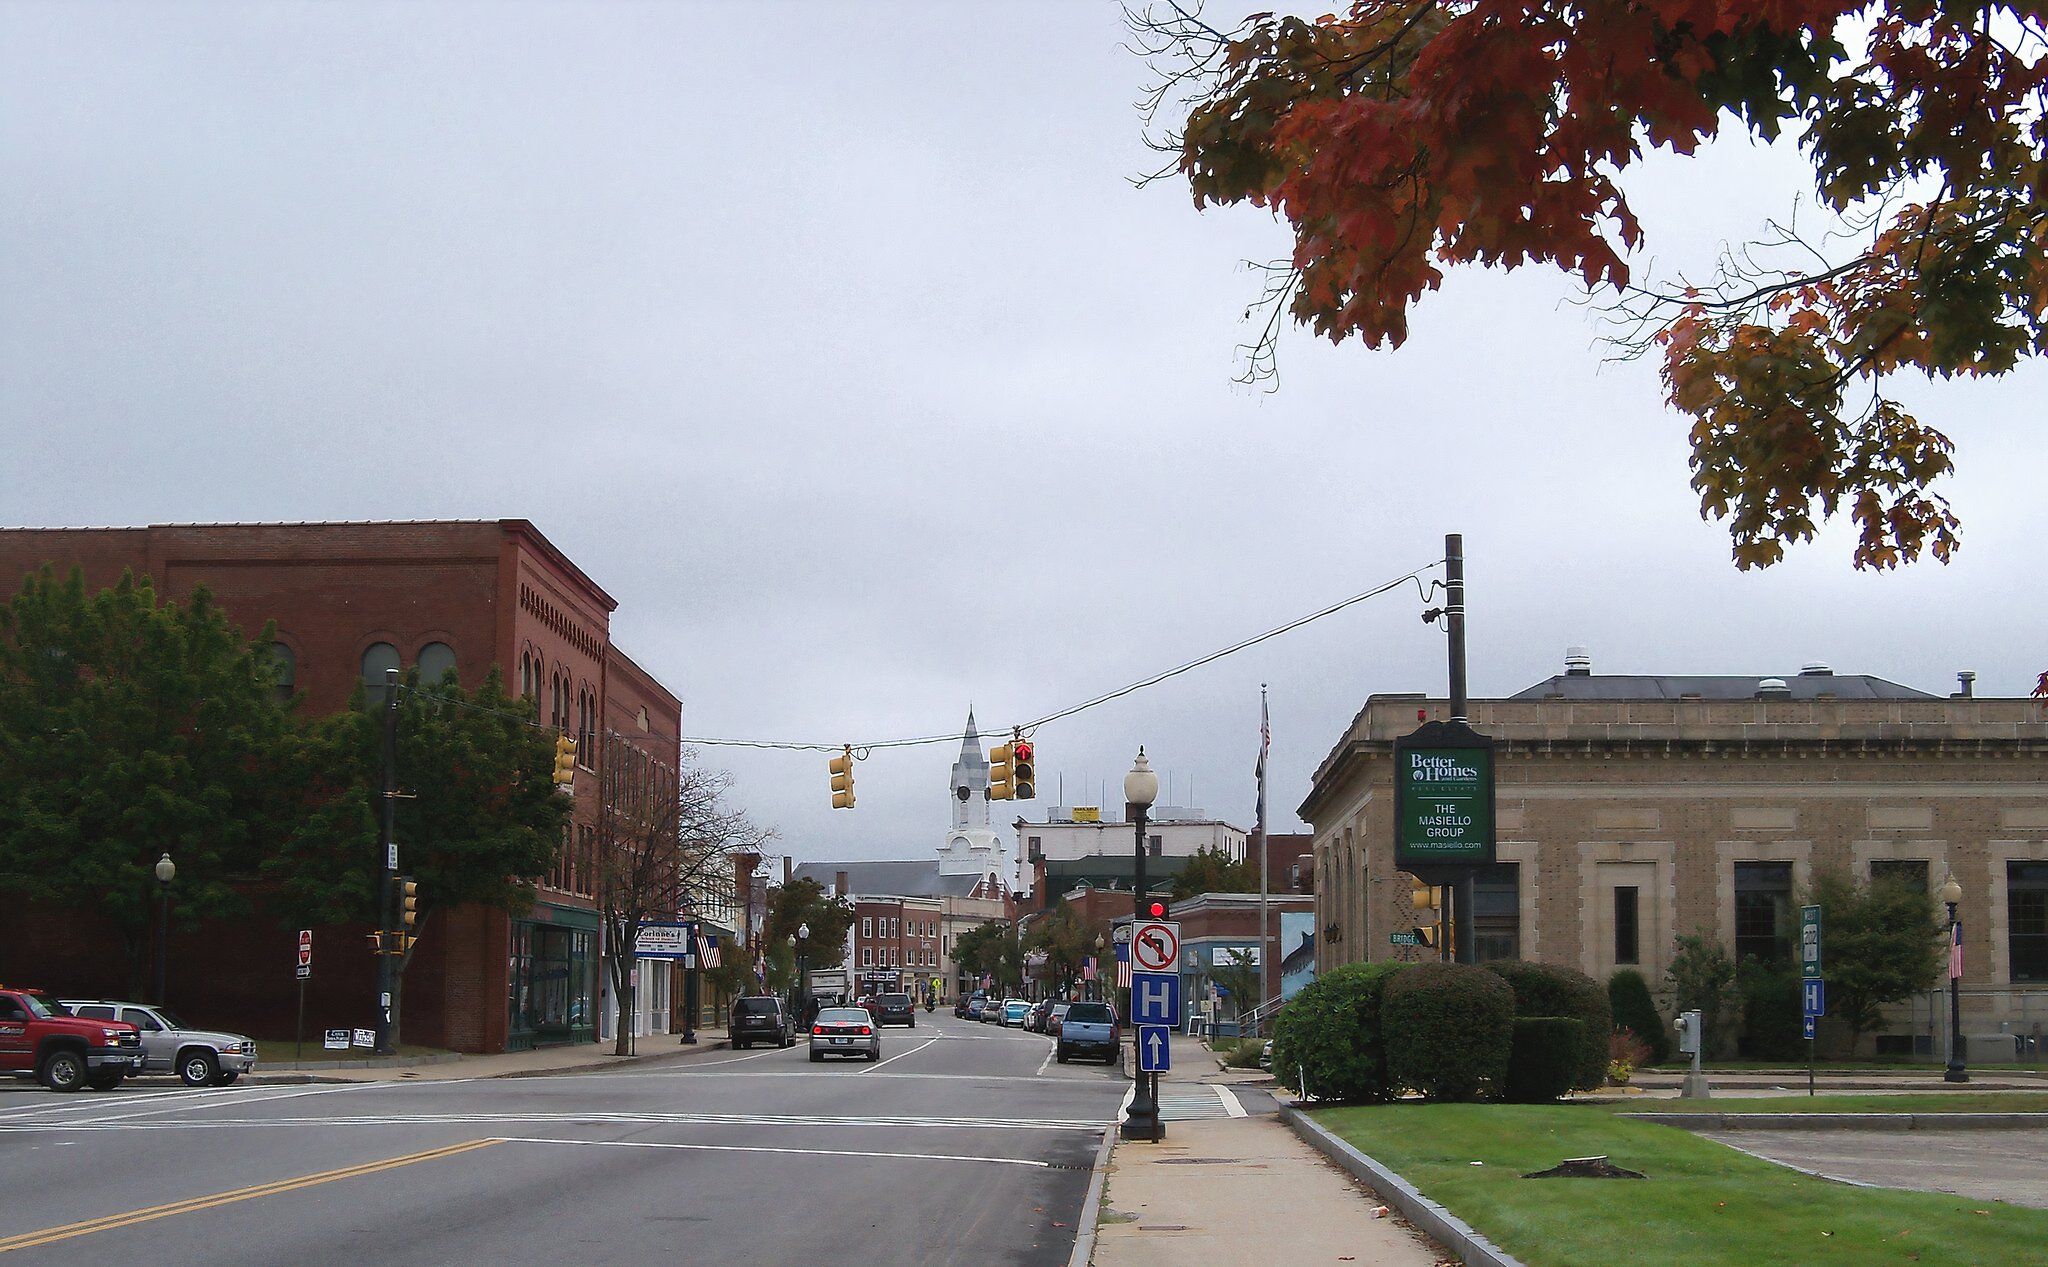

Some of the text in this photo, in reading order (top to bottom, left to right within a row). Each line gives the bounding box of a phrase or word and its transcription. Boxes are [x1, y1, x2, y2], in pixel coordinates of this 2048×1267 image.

[1411, 753, 1455, 768] Better
[1426, 767, 1478, 781] Homes
[1435, 804, 1456, 814] THE
[1419, 816, 1472, 826] MASIELLO
[1426, 827, 1464, 837] GROUP
[1409, 841, 1482, 849] www.masiello.com
[1393, 934, 1415, 943] BRIDGE
[1804, 930, 1817, 946] 202
[1142, 981, 1169, 1018] H
[1806, 984, 1818, 1010] H
